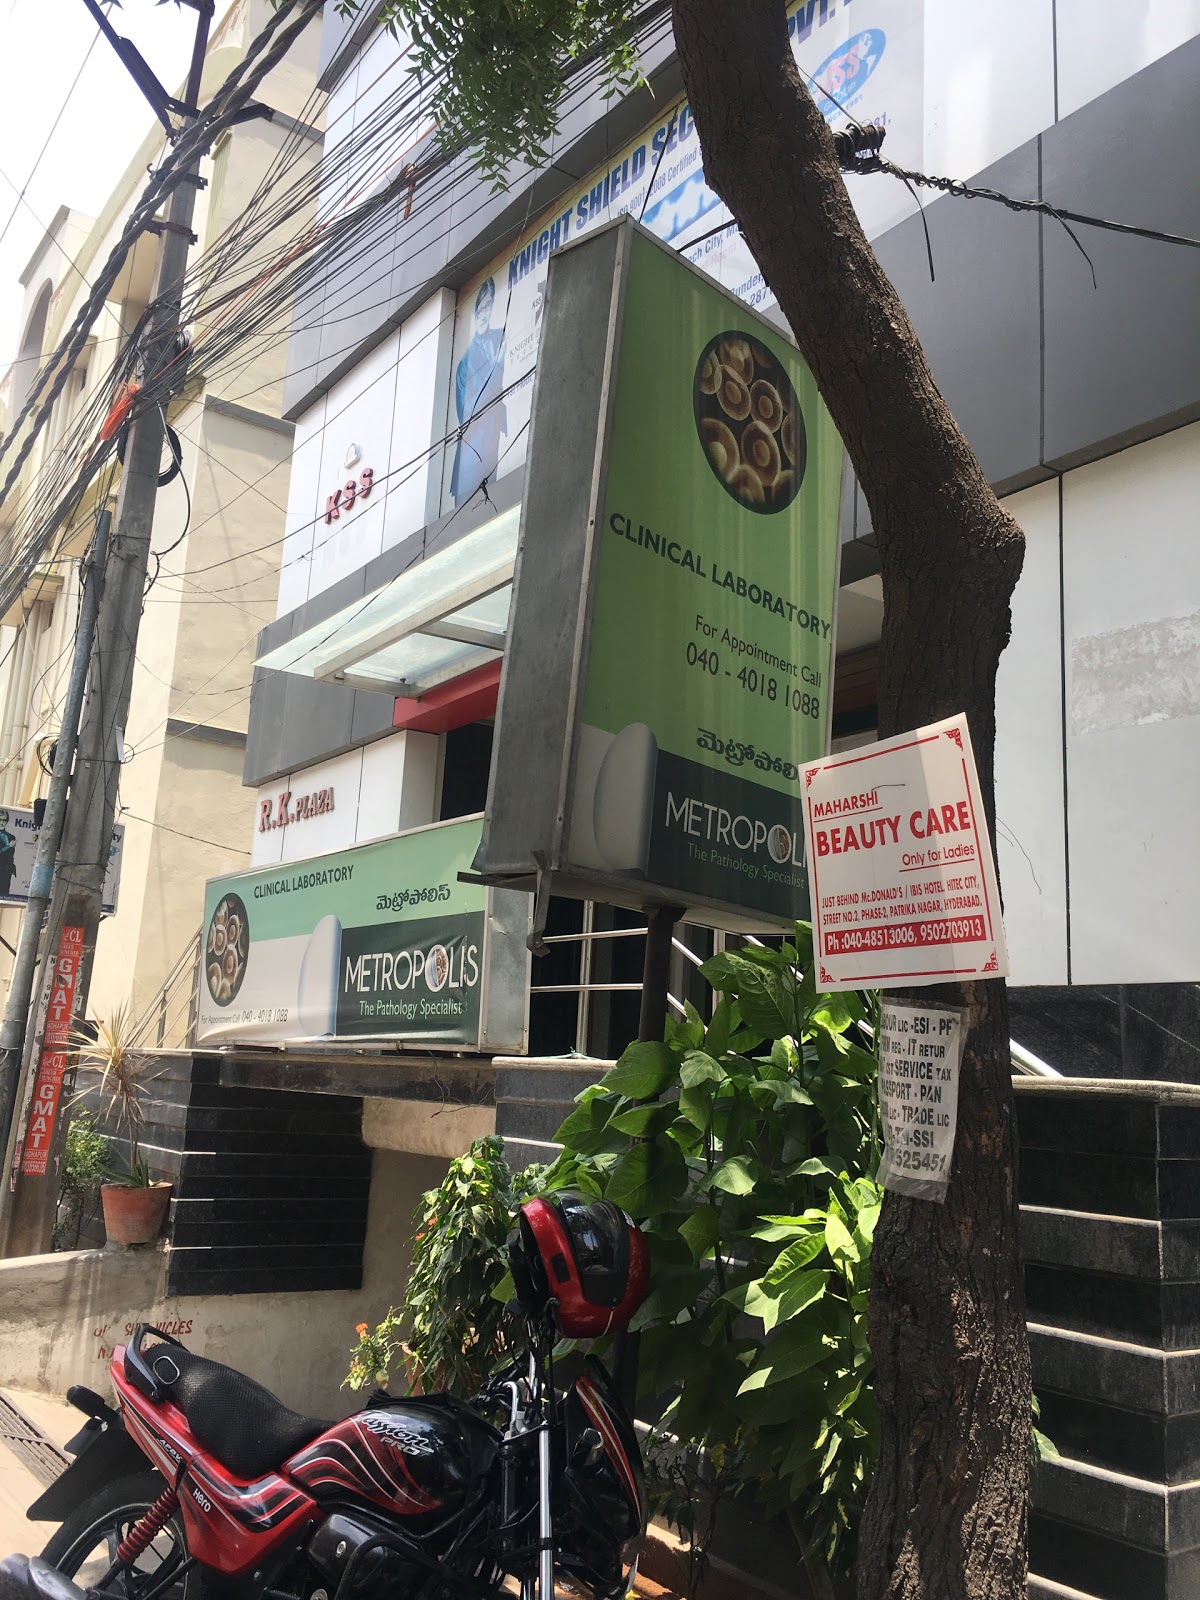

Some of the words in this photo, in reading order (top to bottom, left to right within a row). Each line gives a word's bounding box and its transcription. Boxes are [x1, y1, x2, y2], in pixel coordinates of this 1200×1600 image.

[667, 149, 697, 182] Certified
[507, 207, 574, 290] KNIGHT
[575, 144, 647, 231] SHIELD
[325, 467, 374, 525] KSS
[609, 512, 706, 578] CLINICAL
[711, 563, 832, 640] LABORATORY
[695, 615, 718, 639] For
[720, 628, 798, 678] Appointment
[801, 665, 822, 688] Call
[686, 641, 719, 676] 040
[737, 666, 778, 701] 4018
[785, 685, 820, 720] 1088
[814, 791, 879, 817] MAHARSHI
[816, 815, 901, 857] BEAUTY
[909, 800, 971, 839] CARE
[688, 842, 708, 861] The
[711, 849, 760, 878] Pathology
[763, 865, 805, 889] Specialist
[902, 853, 925, 866] Only
[928, 849, 941, 862] for
[943, 844, 975, 860] Ladies
[253, 880, 291, 899] CLINICAL
[292, 864, 354, 891] LABORATORY
[822, 897, 835, 909] JUST
[837, 893, 859, 907] BEHIND
[910, 886, 922, 896] IBIS
[946, 877, 963, 892] HITEC
[964, 875, 980, 890] CITY,
[823, 913, 842, 925] STREET
[861, 906, 889, 921] PHASE-2,
[889, 901, 917, 917] PATRIKA
[917, 899, 943, 914] NAGAR,
[944, 894, 983, 911] HYDERABAD.
[919, 918, 982, 941] 9502703913
[344, 944, 479, 993] METROPOLIS
[241, 1010, 253, 1022] 040
[257, 1009, 272, 1022] 4018
[359, 1000, 374, 1016] The
[376, 999, 418, 1020] Pathology
[419, 998, 463, 1021] Specialist
[897, 1020, 909, 1033] LIC
[939, 1018, 953, 1036] PF
[907, 1038, 918, 1056] IT
[894, 1058, 934, 1080] SERVICE
[936, 1067, 952, 1081] TAX
[920, 1084, 942, 1104] PAN
[32, 1084, 56, 1149] GMAT
[901, 1104, 934, 1126] TRADE
[937, 1113, 950, 1128] LIC
[380, 1436, 420, 1456] PRO
[192, 1488, 211, 1512] Hero
